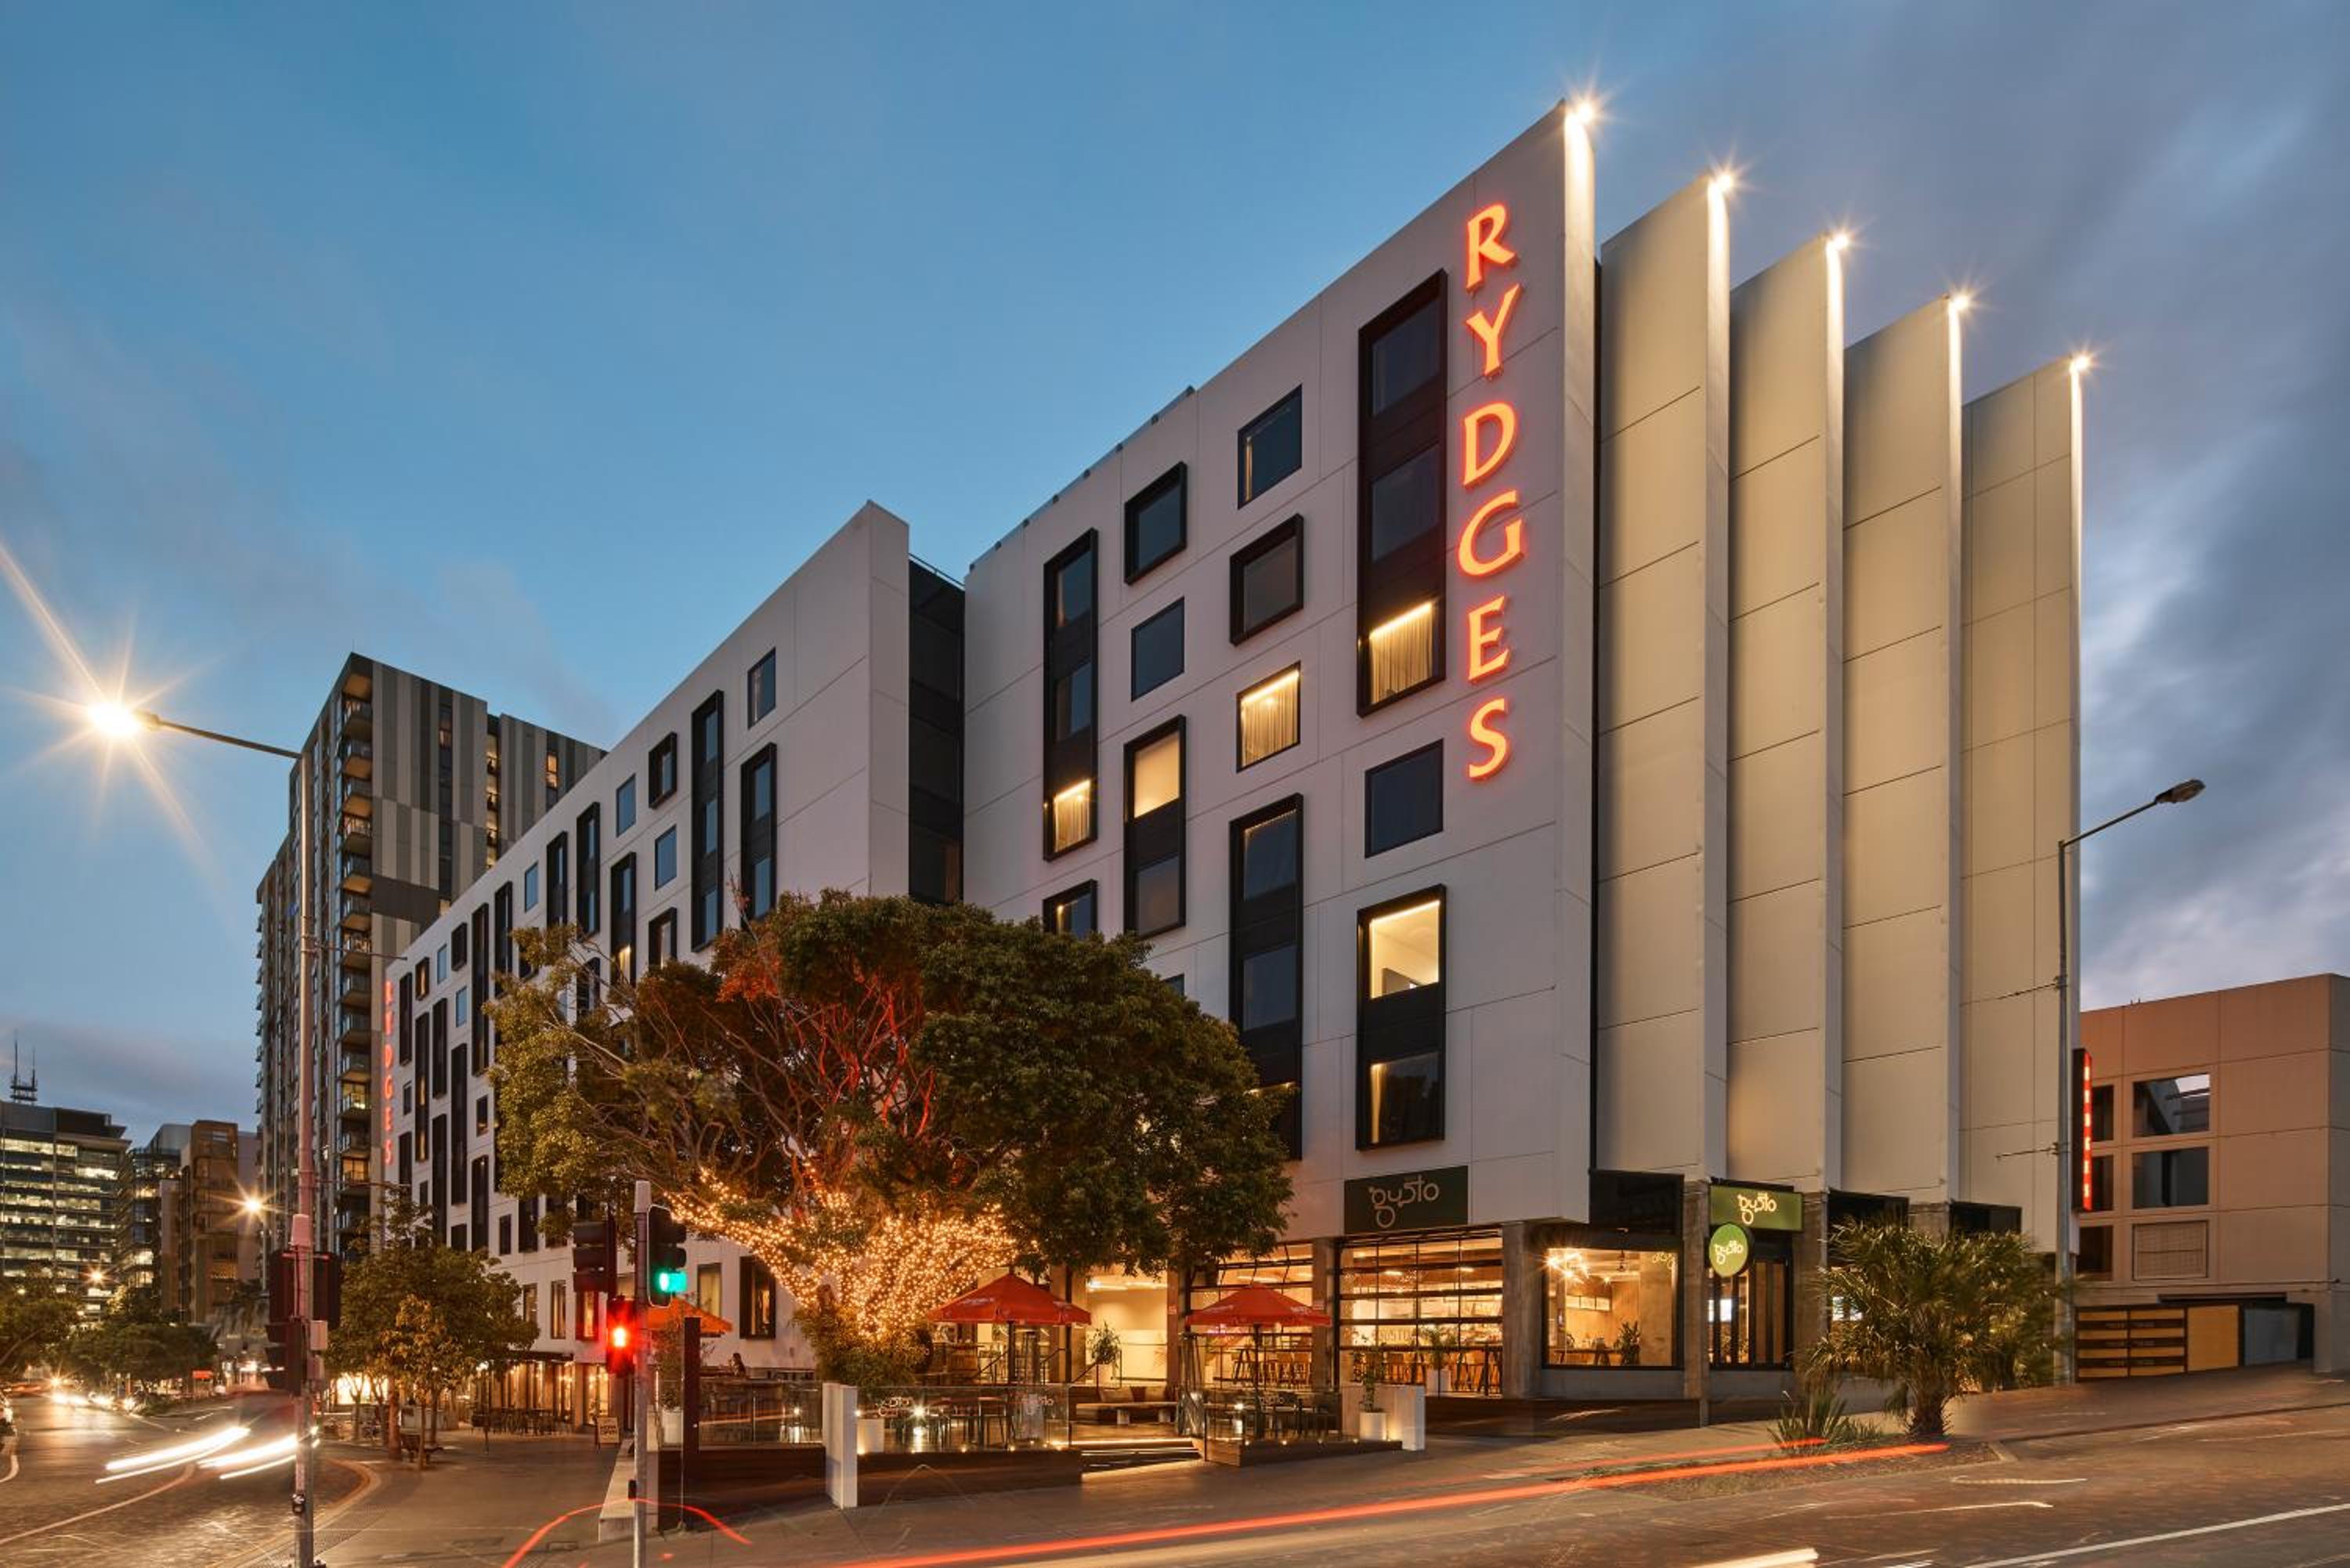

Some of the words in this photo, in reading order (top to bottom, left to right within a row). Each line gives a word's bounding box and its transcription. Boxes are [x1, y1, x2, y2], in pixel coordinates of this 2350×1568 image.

[1458, 204, 1522, 779] RYDGES
[1368, 1175, 1440, 1228] gusto
[1737, 1192, 1777, 1225] gusto
